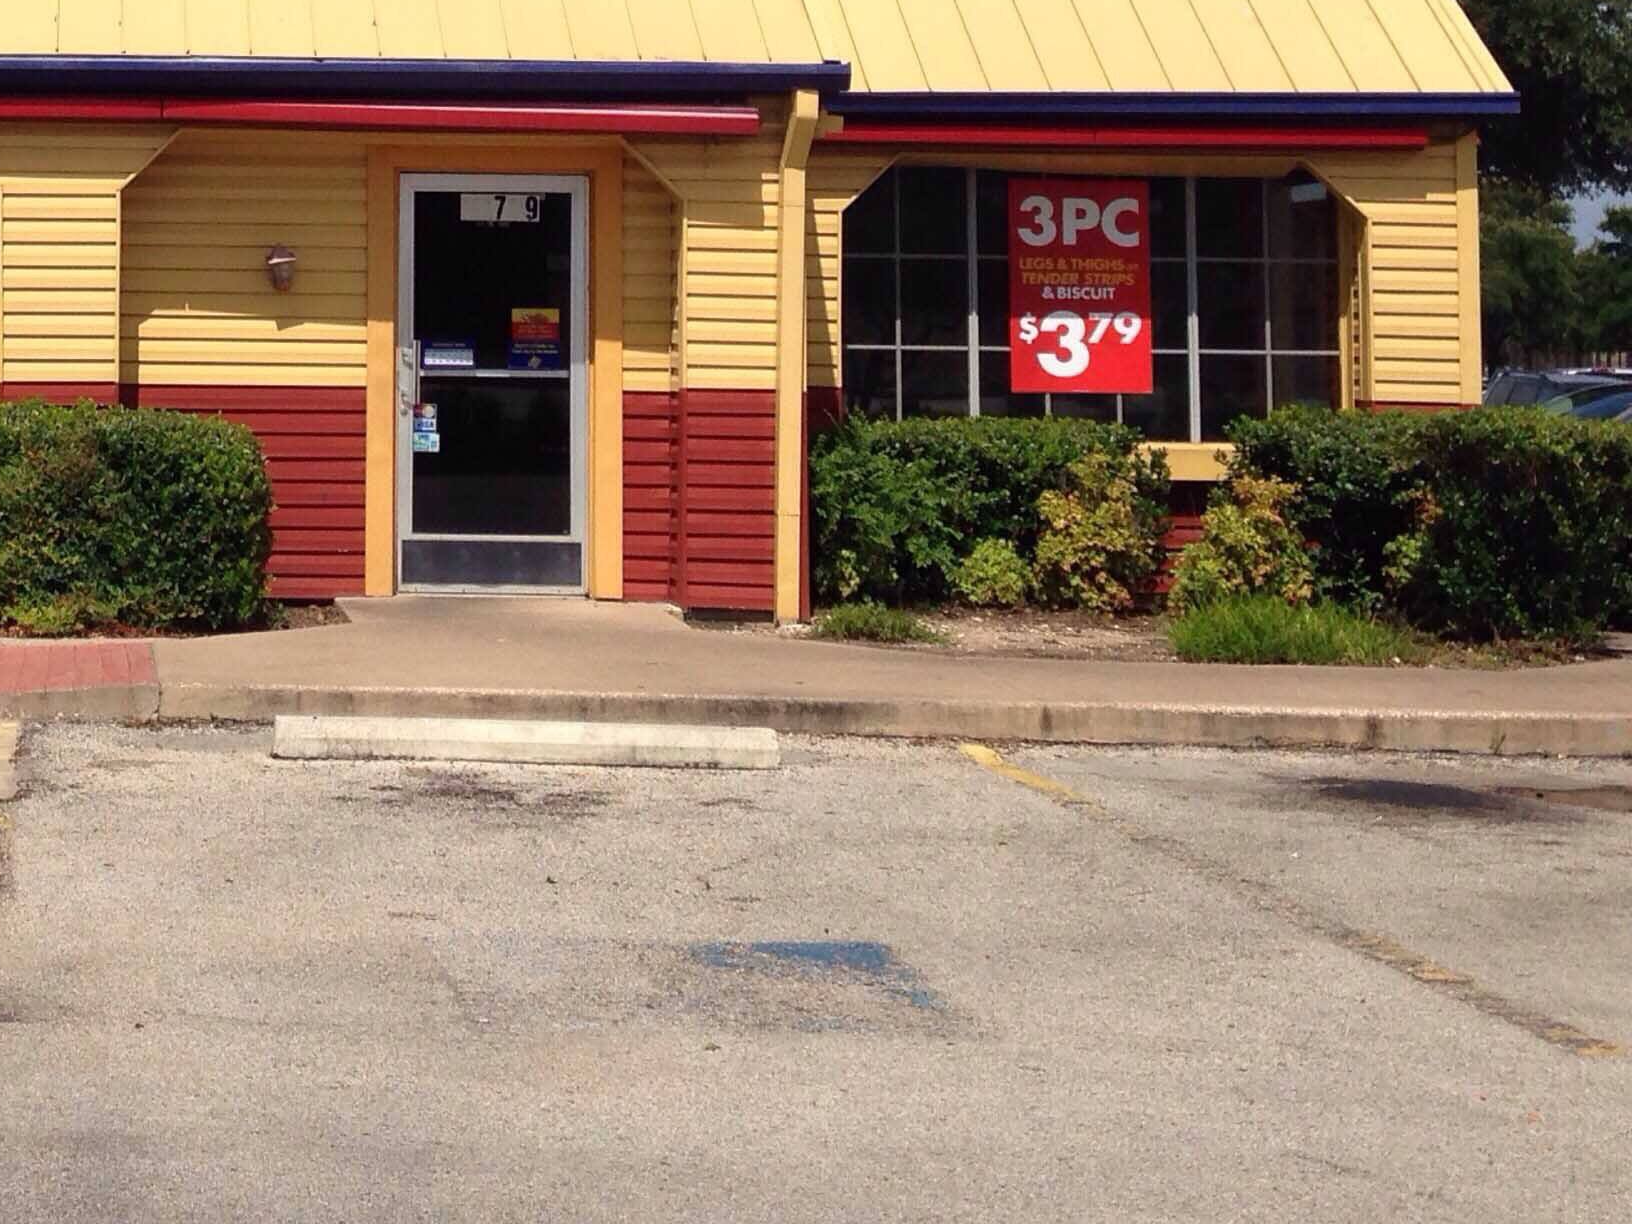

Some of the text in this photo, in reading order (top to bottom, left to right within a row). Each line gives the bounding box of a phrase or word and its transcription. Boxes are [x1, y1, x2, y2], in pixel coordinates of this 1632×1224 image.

[1019, 257, 1055, 270] LEGS
[1058, 257, 1068, 270] &
[1070, 258, 1125, 271] THIGHS
[1022, 273, 1135, 287] TENDER STRIPS
[1042, 286, 1116, 300] & BISCUIT
